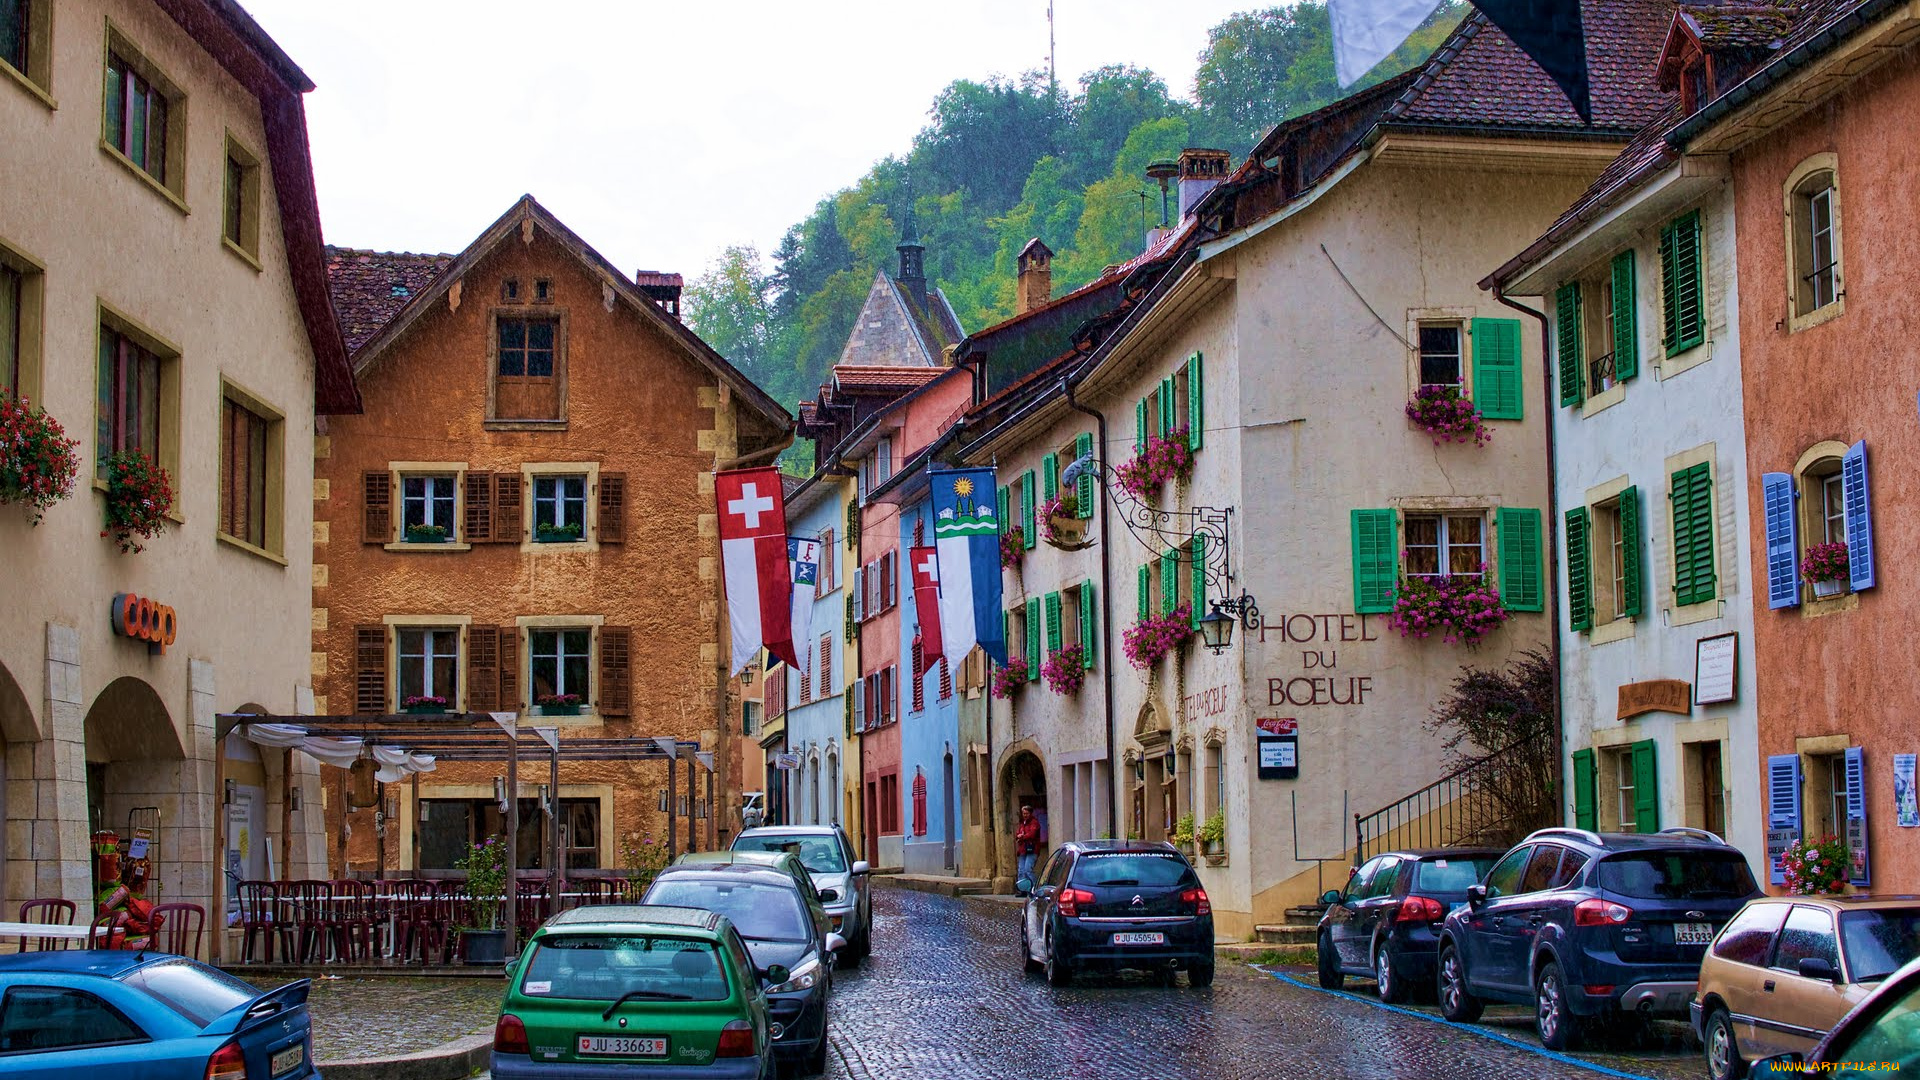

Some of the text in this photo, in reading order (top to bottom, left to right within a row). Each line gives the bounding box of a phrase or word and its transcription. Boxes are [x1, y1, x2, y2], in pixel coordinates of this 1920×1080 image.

[113, 593, 177, 656] coop
[1258, 614, 1378, 643] HOTEL
[1303, 650, 1337, 669] DU
[1267, 676, 1374, 706] BŒUF
[679, 1046, 711, 1061] twingo
